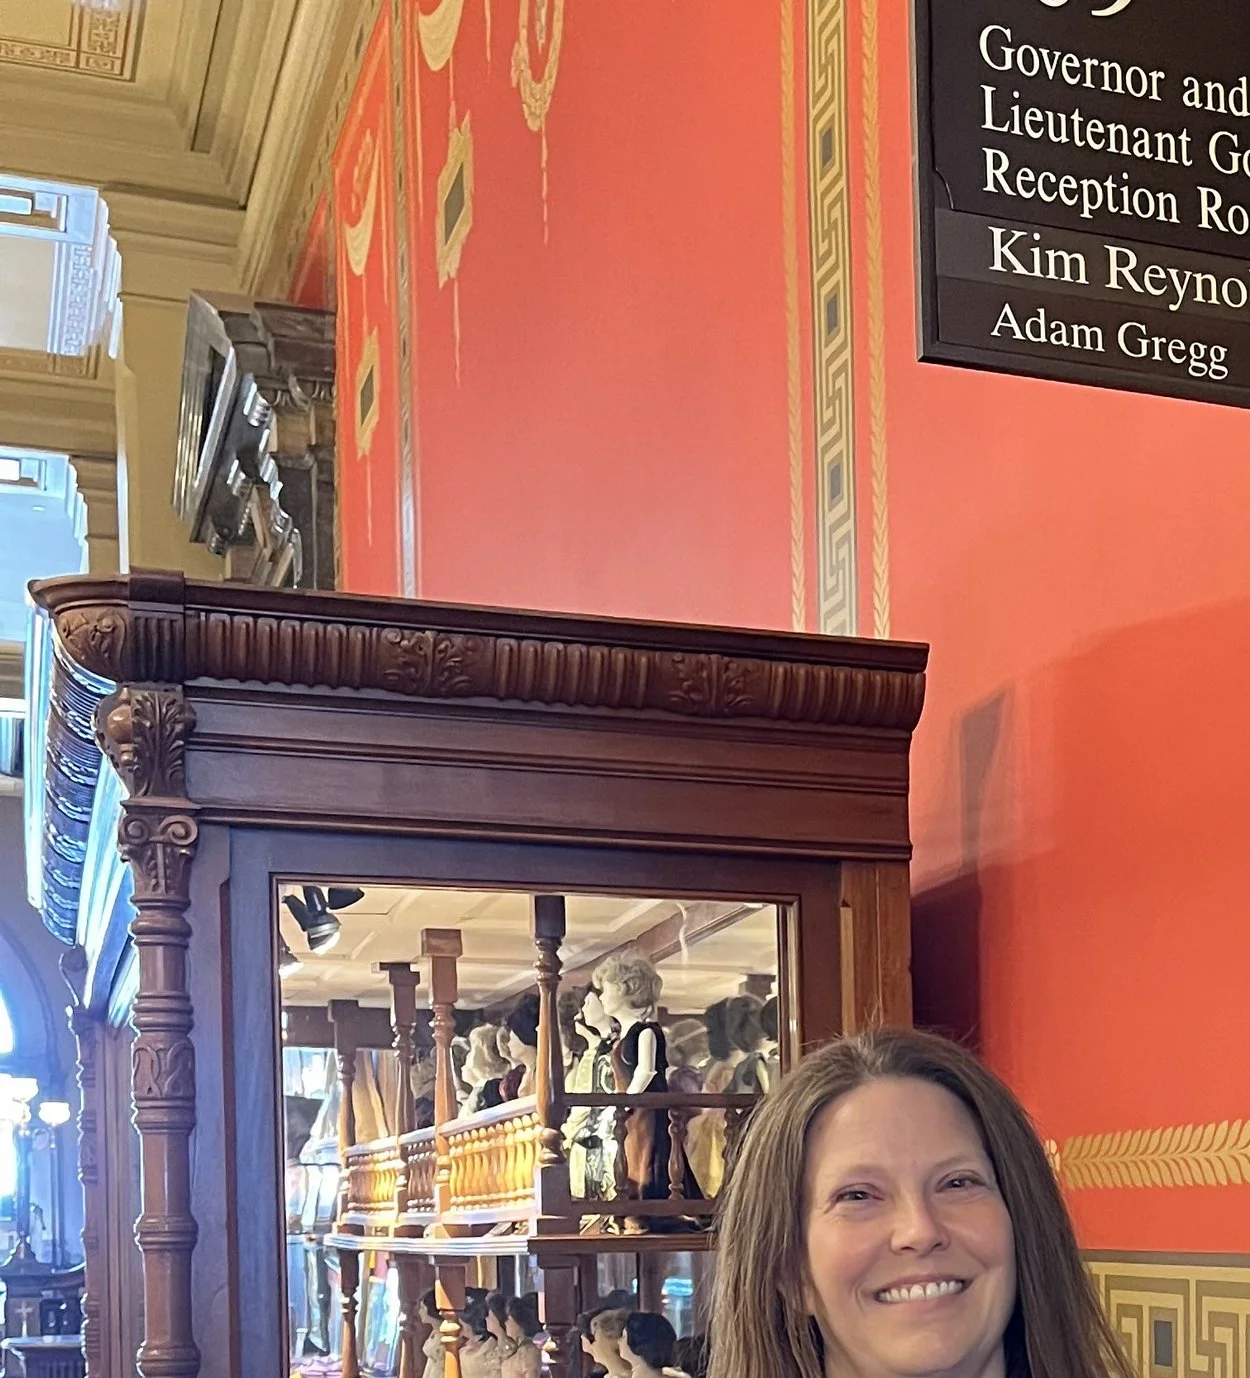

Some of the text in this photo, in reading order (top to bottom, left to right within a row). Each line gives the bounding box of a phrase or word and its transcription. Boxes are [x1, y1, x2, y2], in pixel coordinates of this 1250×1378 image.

[979, 25, 1250, 117] Governor and
[980, 85, 1193, 166] Lieutenant
[982, 148, 1181, 223] Reception
[988, 227, 1090, 285] Kim
[990, 303, 1229, 380] Adam Gregg
